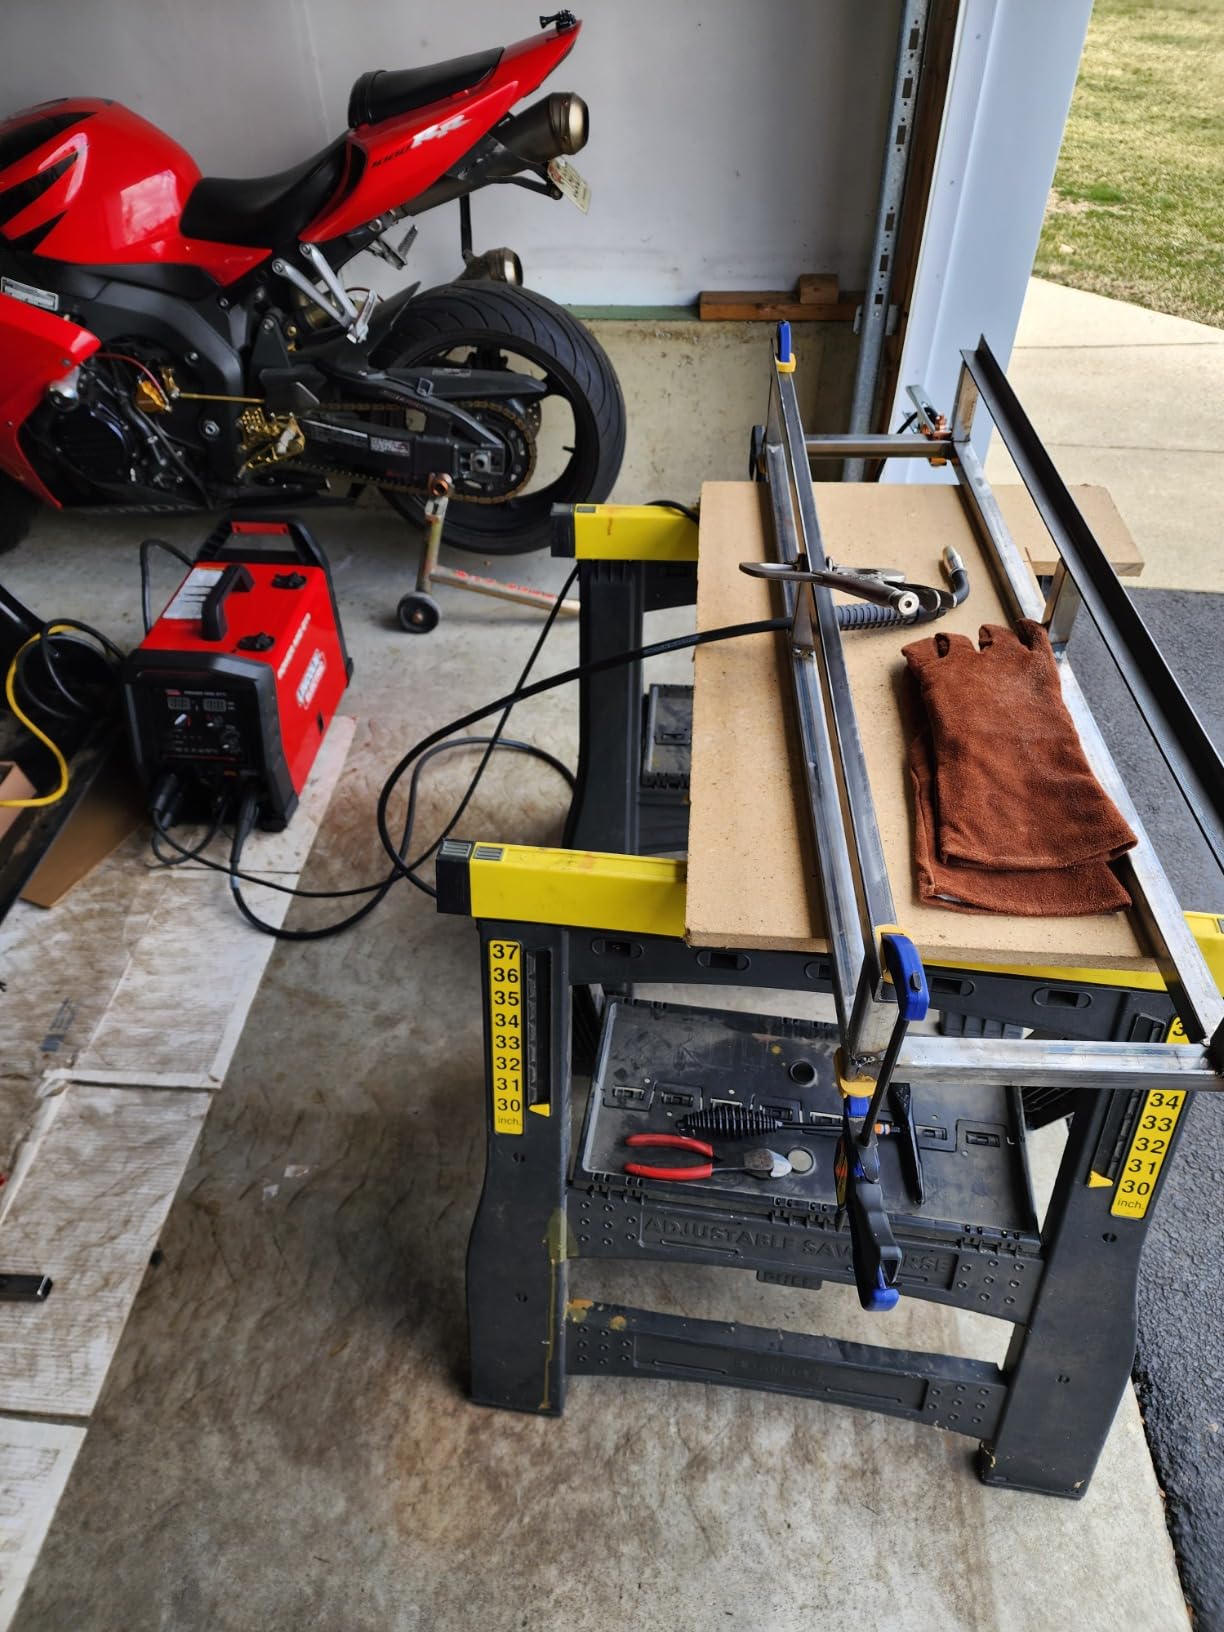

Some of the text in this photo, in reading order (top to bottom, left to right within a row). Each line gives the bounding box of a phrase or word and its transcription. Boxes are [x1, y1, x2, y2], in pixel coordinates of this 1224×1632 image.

[493, 944, 518, 960] 37
[494, 968, 518, 984] 36
[494, 991, 519, 1007] 35
[495, 1013, 519, 1029] 34
[496, 1035, 520, 1050] 33
[496, 1057, 520, 1072] 32
[497, 1078, 519, 1092] 31
[497, 1098, 521, 1112] 30
[1149, 1092, 1179, 1110] 34
[1142, 1115, 1173, 1132] 33
[1135, 1137, 1165, 1155] 32
[1128, 1158, 1157, 1175] 31
[1121, 1179, 1151, 1196] 30
[645, 1216, 794, 1250] ADJUSTABLE
